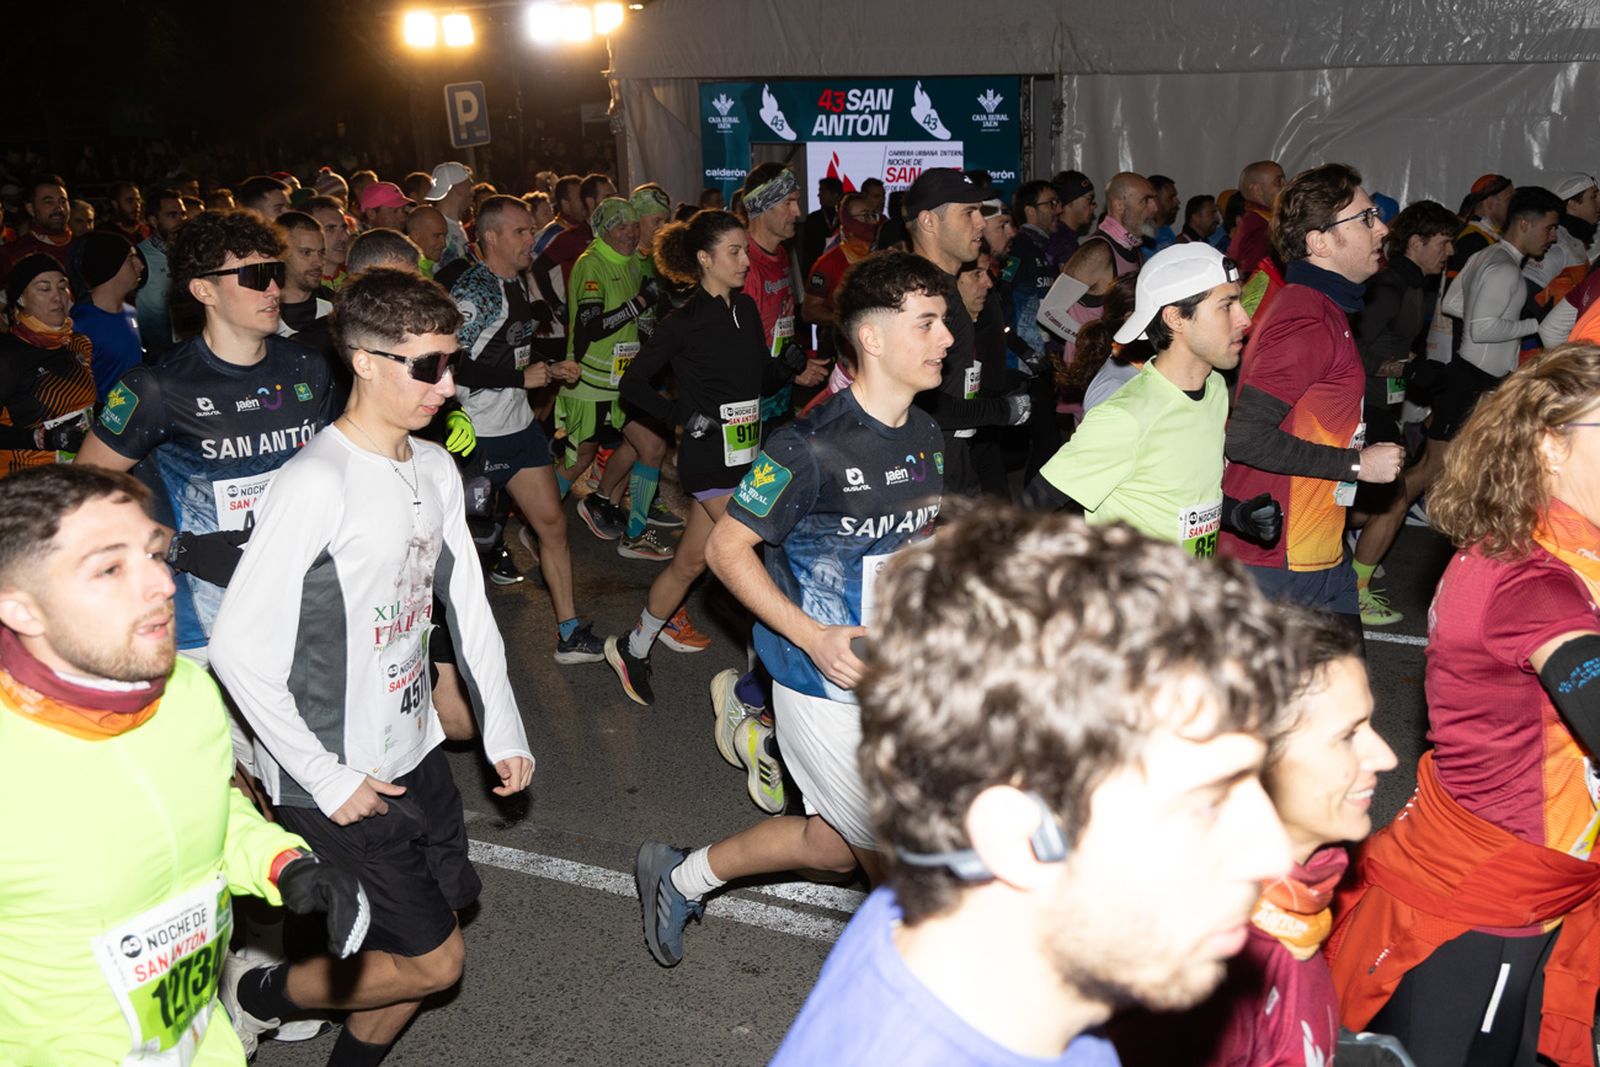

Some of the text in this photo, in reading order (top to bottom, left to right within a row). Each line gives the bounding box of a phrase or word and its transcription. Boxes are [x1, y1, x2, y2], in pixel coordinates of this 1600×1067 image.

[818, 88, 894, 113] 43 SAN
[454, 91, 478, 139] P
[811, 107, 890, 136] ANTÓN
[888, 158, 923, 166] NOCHE DE
[885, 167, 922, 183] SAN
[201, 436, 253, 460] SAN
[229, 500, 251, 511] SAN
[837, 514, 895, 539] SAN
[1188, 524, 1205, 538] SAN
[388, 674, 407, 693] SAN
[146, 916, 190, 950] NOCHE
[192, 908, 208, 928] DE
[134, 953, 170, 983] SAN
